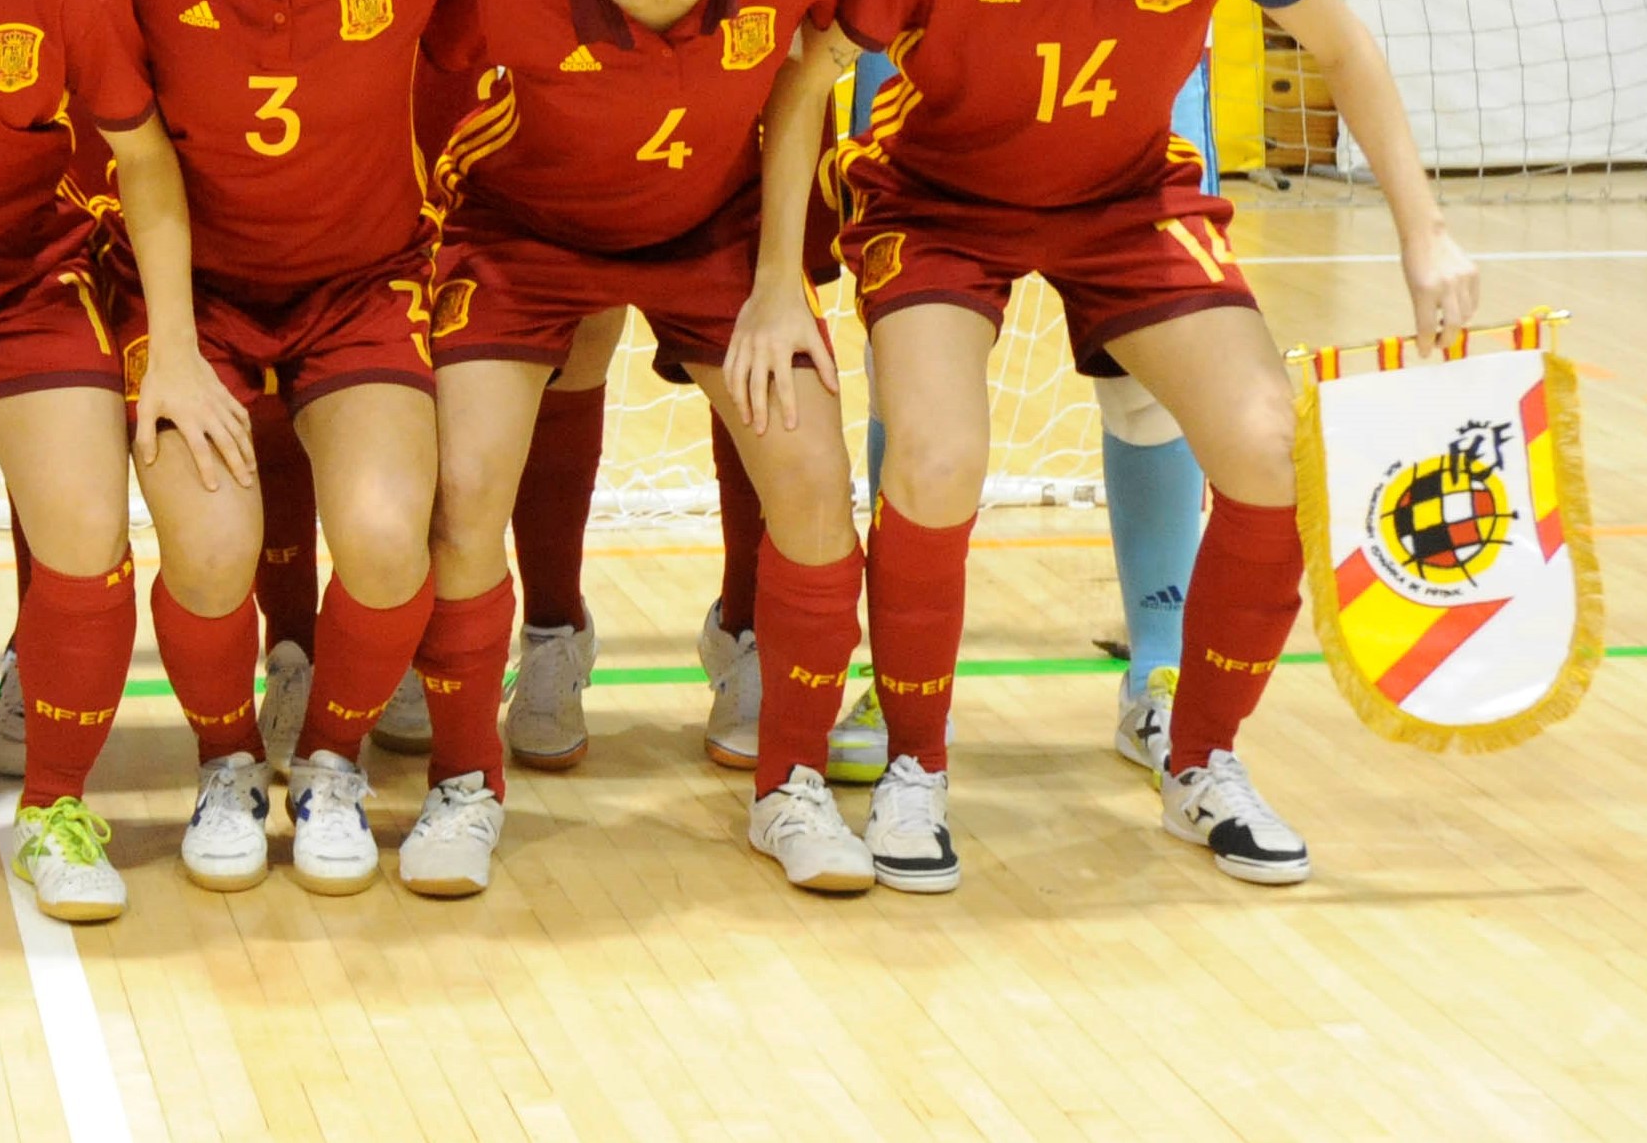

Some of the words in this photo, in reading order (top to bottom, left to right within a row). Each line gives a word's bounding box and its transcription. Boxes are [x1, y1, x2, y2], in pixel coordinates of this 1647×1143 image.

[179, 14, 220, 30] adidas
[559, 62, 602, 72] adidas
[1037, 39, 1117, 123] 14
[246, 77, 301, 156] 3
[636, 108, 692, 169] 4
[881, 673, 953, 696] RFEF
[36, 699, 115, 726] RFEF
